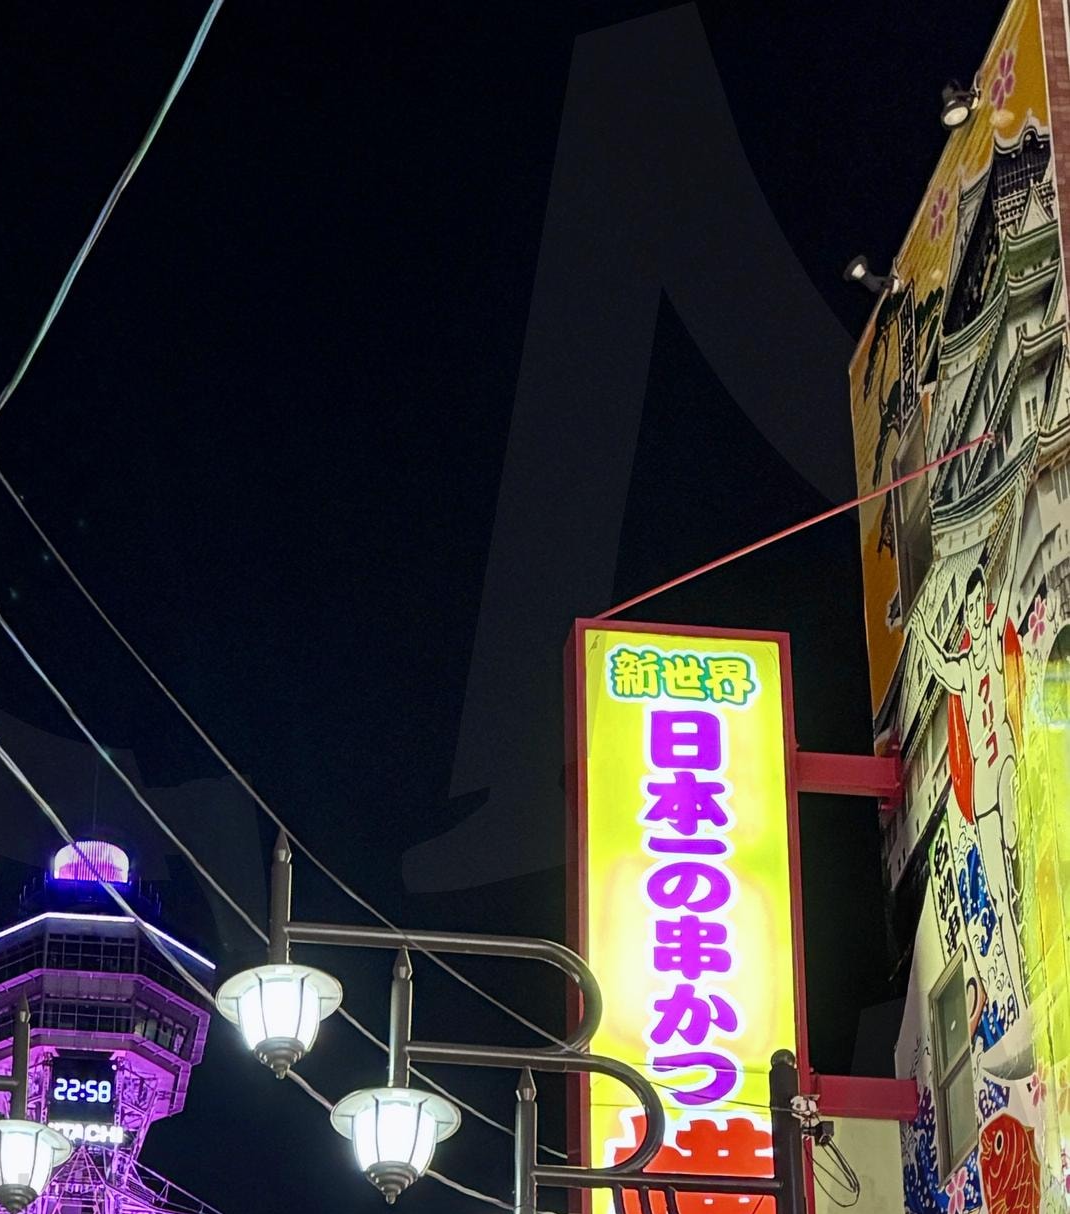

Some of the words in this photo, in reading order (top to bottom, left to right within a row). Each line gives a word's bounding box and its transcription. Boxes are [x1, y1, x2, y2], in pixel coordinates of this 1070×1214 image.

[613, 649, 754, 706] 新世界
[645, 710, 739, 1107] 日本一の串かつ
[54, 1078, 111, 1103] 22:58
